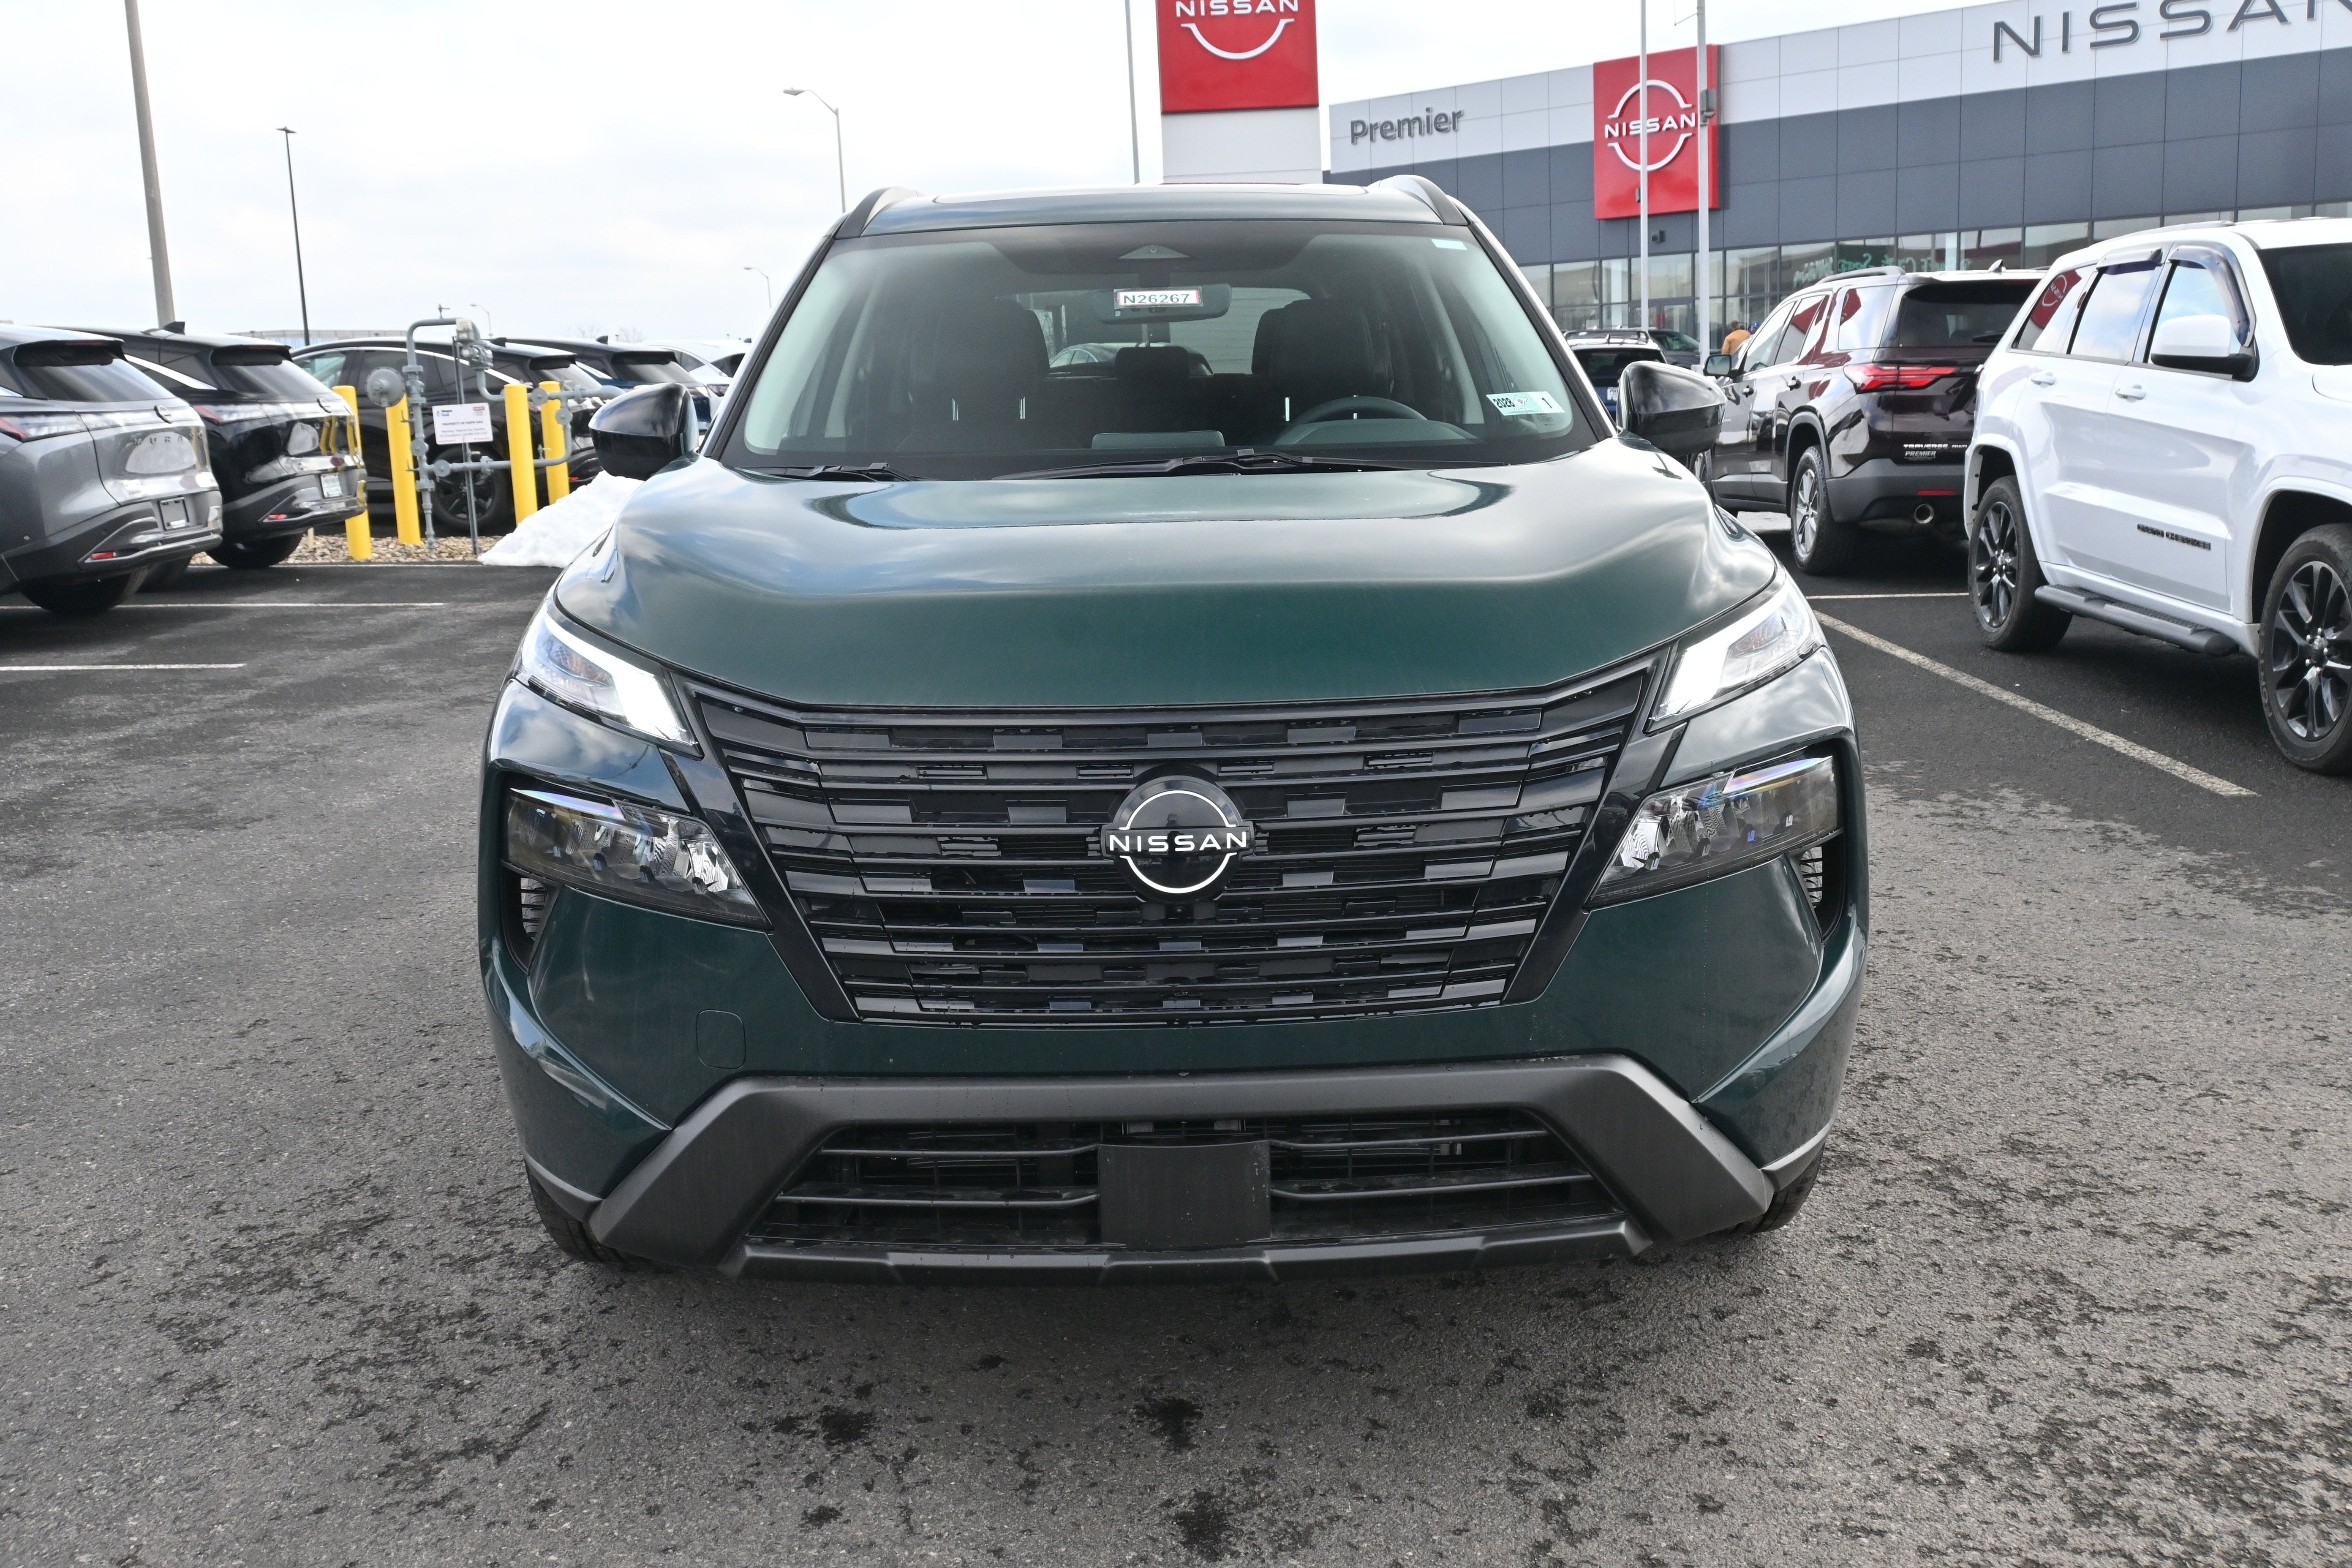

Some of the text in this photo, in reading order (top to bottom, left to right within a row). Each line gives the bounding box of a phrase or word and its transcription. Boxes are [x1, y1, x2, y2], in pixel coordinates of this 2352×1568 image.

[1176, 0, 1298, 18] NISSAN
[1350, 106, 1464, 144] Premier
[1604, 112, 1696, 139] NISSAN
[1123, 294, 1190, 304] N26267
[1493, 397, 1516, 408] 2028
[1541, 397, 1553, 408] 1
[1109, 831, 1247, 852] NISSAN
